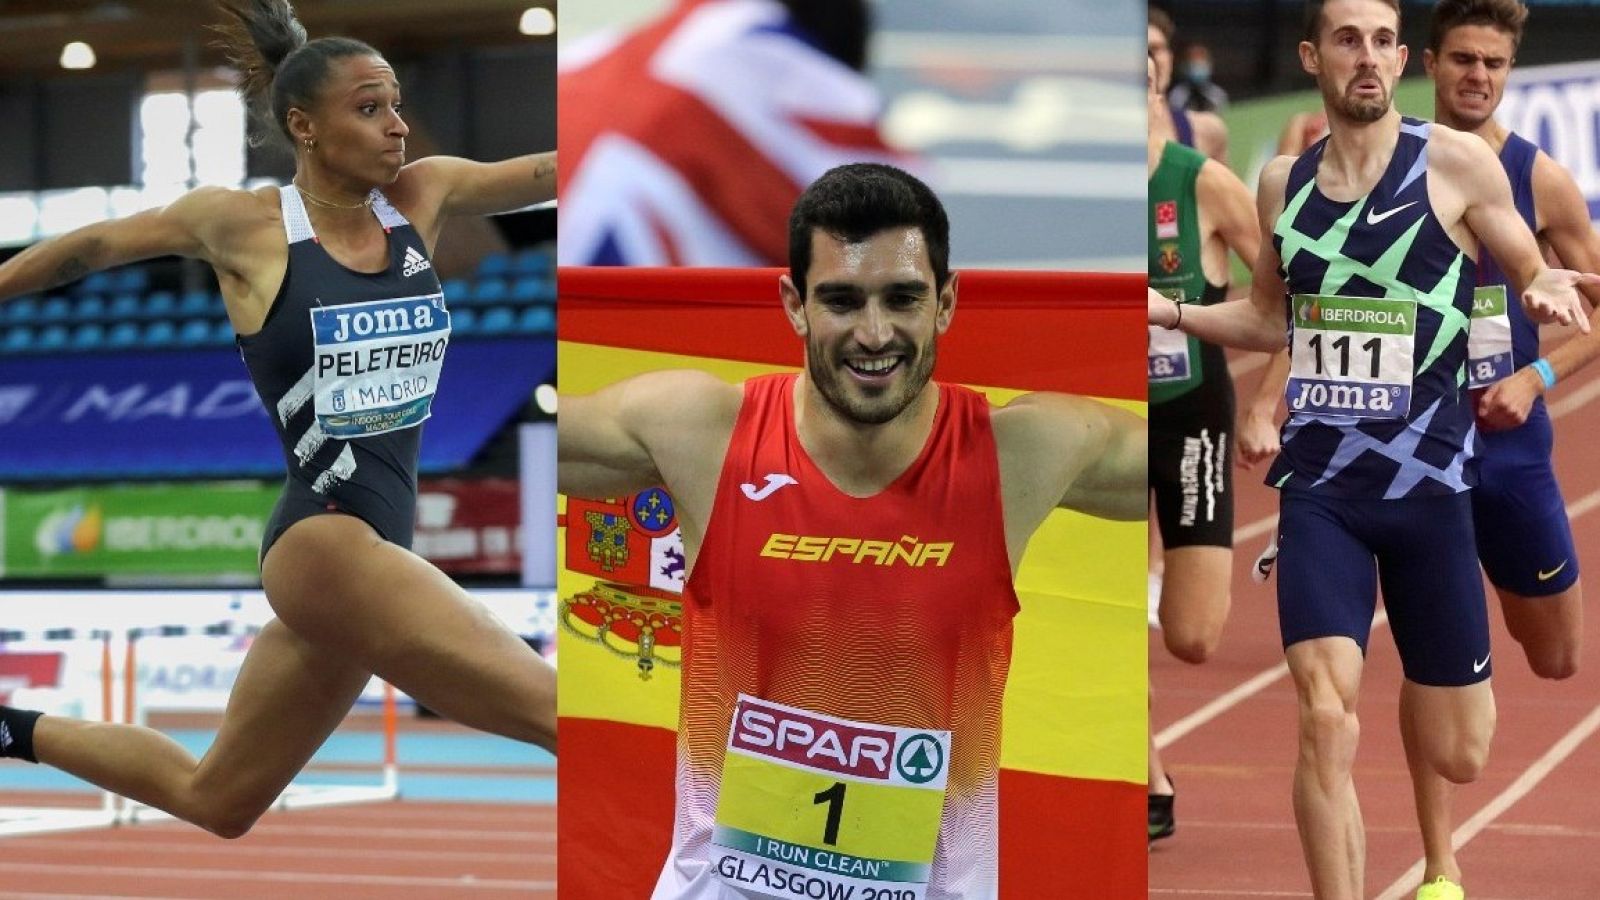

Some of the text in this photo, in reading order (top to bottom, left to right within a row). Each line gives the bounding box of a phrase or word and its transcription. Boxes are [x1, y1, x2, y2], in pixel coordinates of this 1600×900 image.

[1321, 308, 1407, 326] IBERDROLA
[318, 338, 446, 378] PELETEIRO
[1308, 334, 1382, 378] 111
[358, 375, 428, 406] MADRID
[760, 533, 954, 567] ESPAÑA
[738, 709, 889, 772] SPAR
[813, 782, 847, 847] 1
[756, 837, 763, 853] I
[767, 840, 810, 865] RUN
[717, 855, 855, 900] GLASGOW
